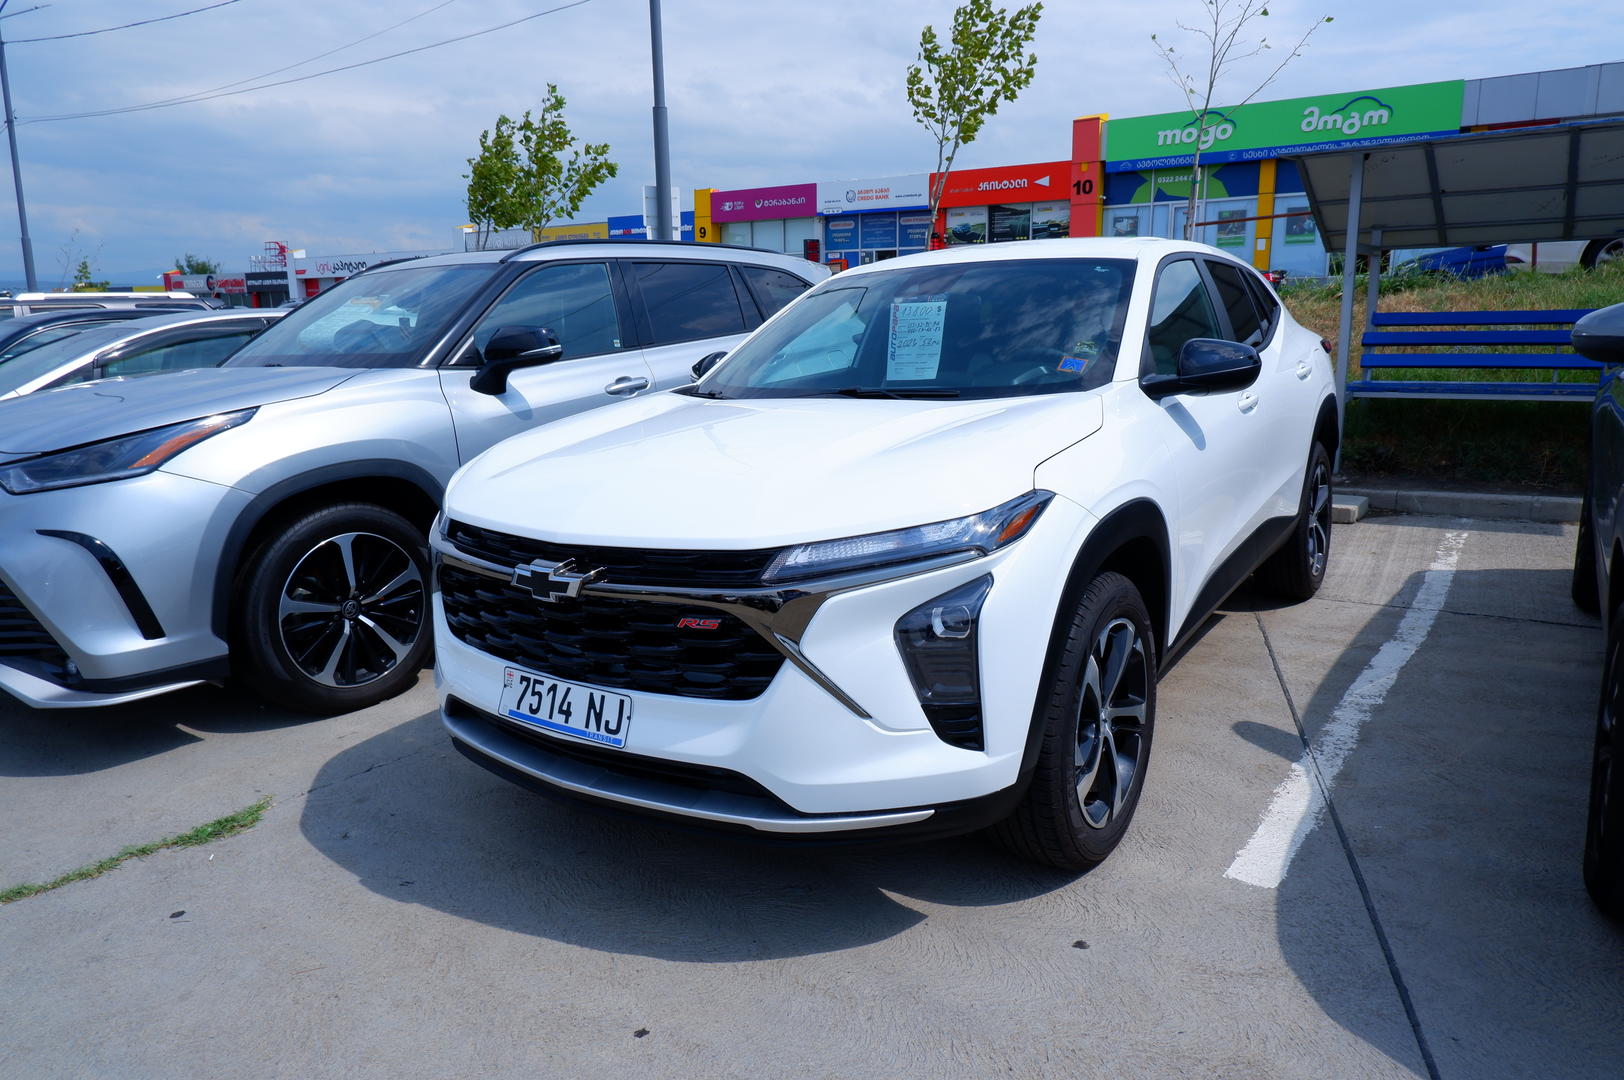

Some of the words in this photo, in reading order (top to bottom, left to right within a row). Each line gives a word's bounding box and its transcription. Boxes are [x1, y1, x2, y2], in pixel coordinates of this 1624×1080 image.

[1300, 106, 1389, 135] მოგო
[1157, 123, 1233, 150] mogo
[977, 178, 1028, 192] კრისტალი
[1073, 179, 1093, 195] 10
[699, 226, 707, 238] 9
[677, 617, 722, 630] RS
[516, 674, 572, 724] 7514
[585, 692, 625, 735] NJ
[586, 731, 614, 743] TRANSIT
